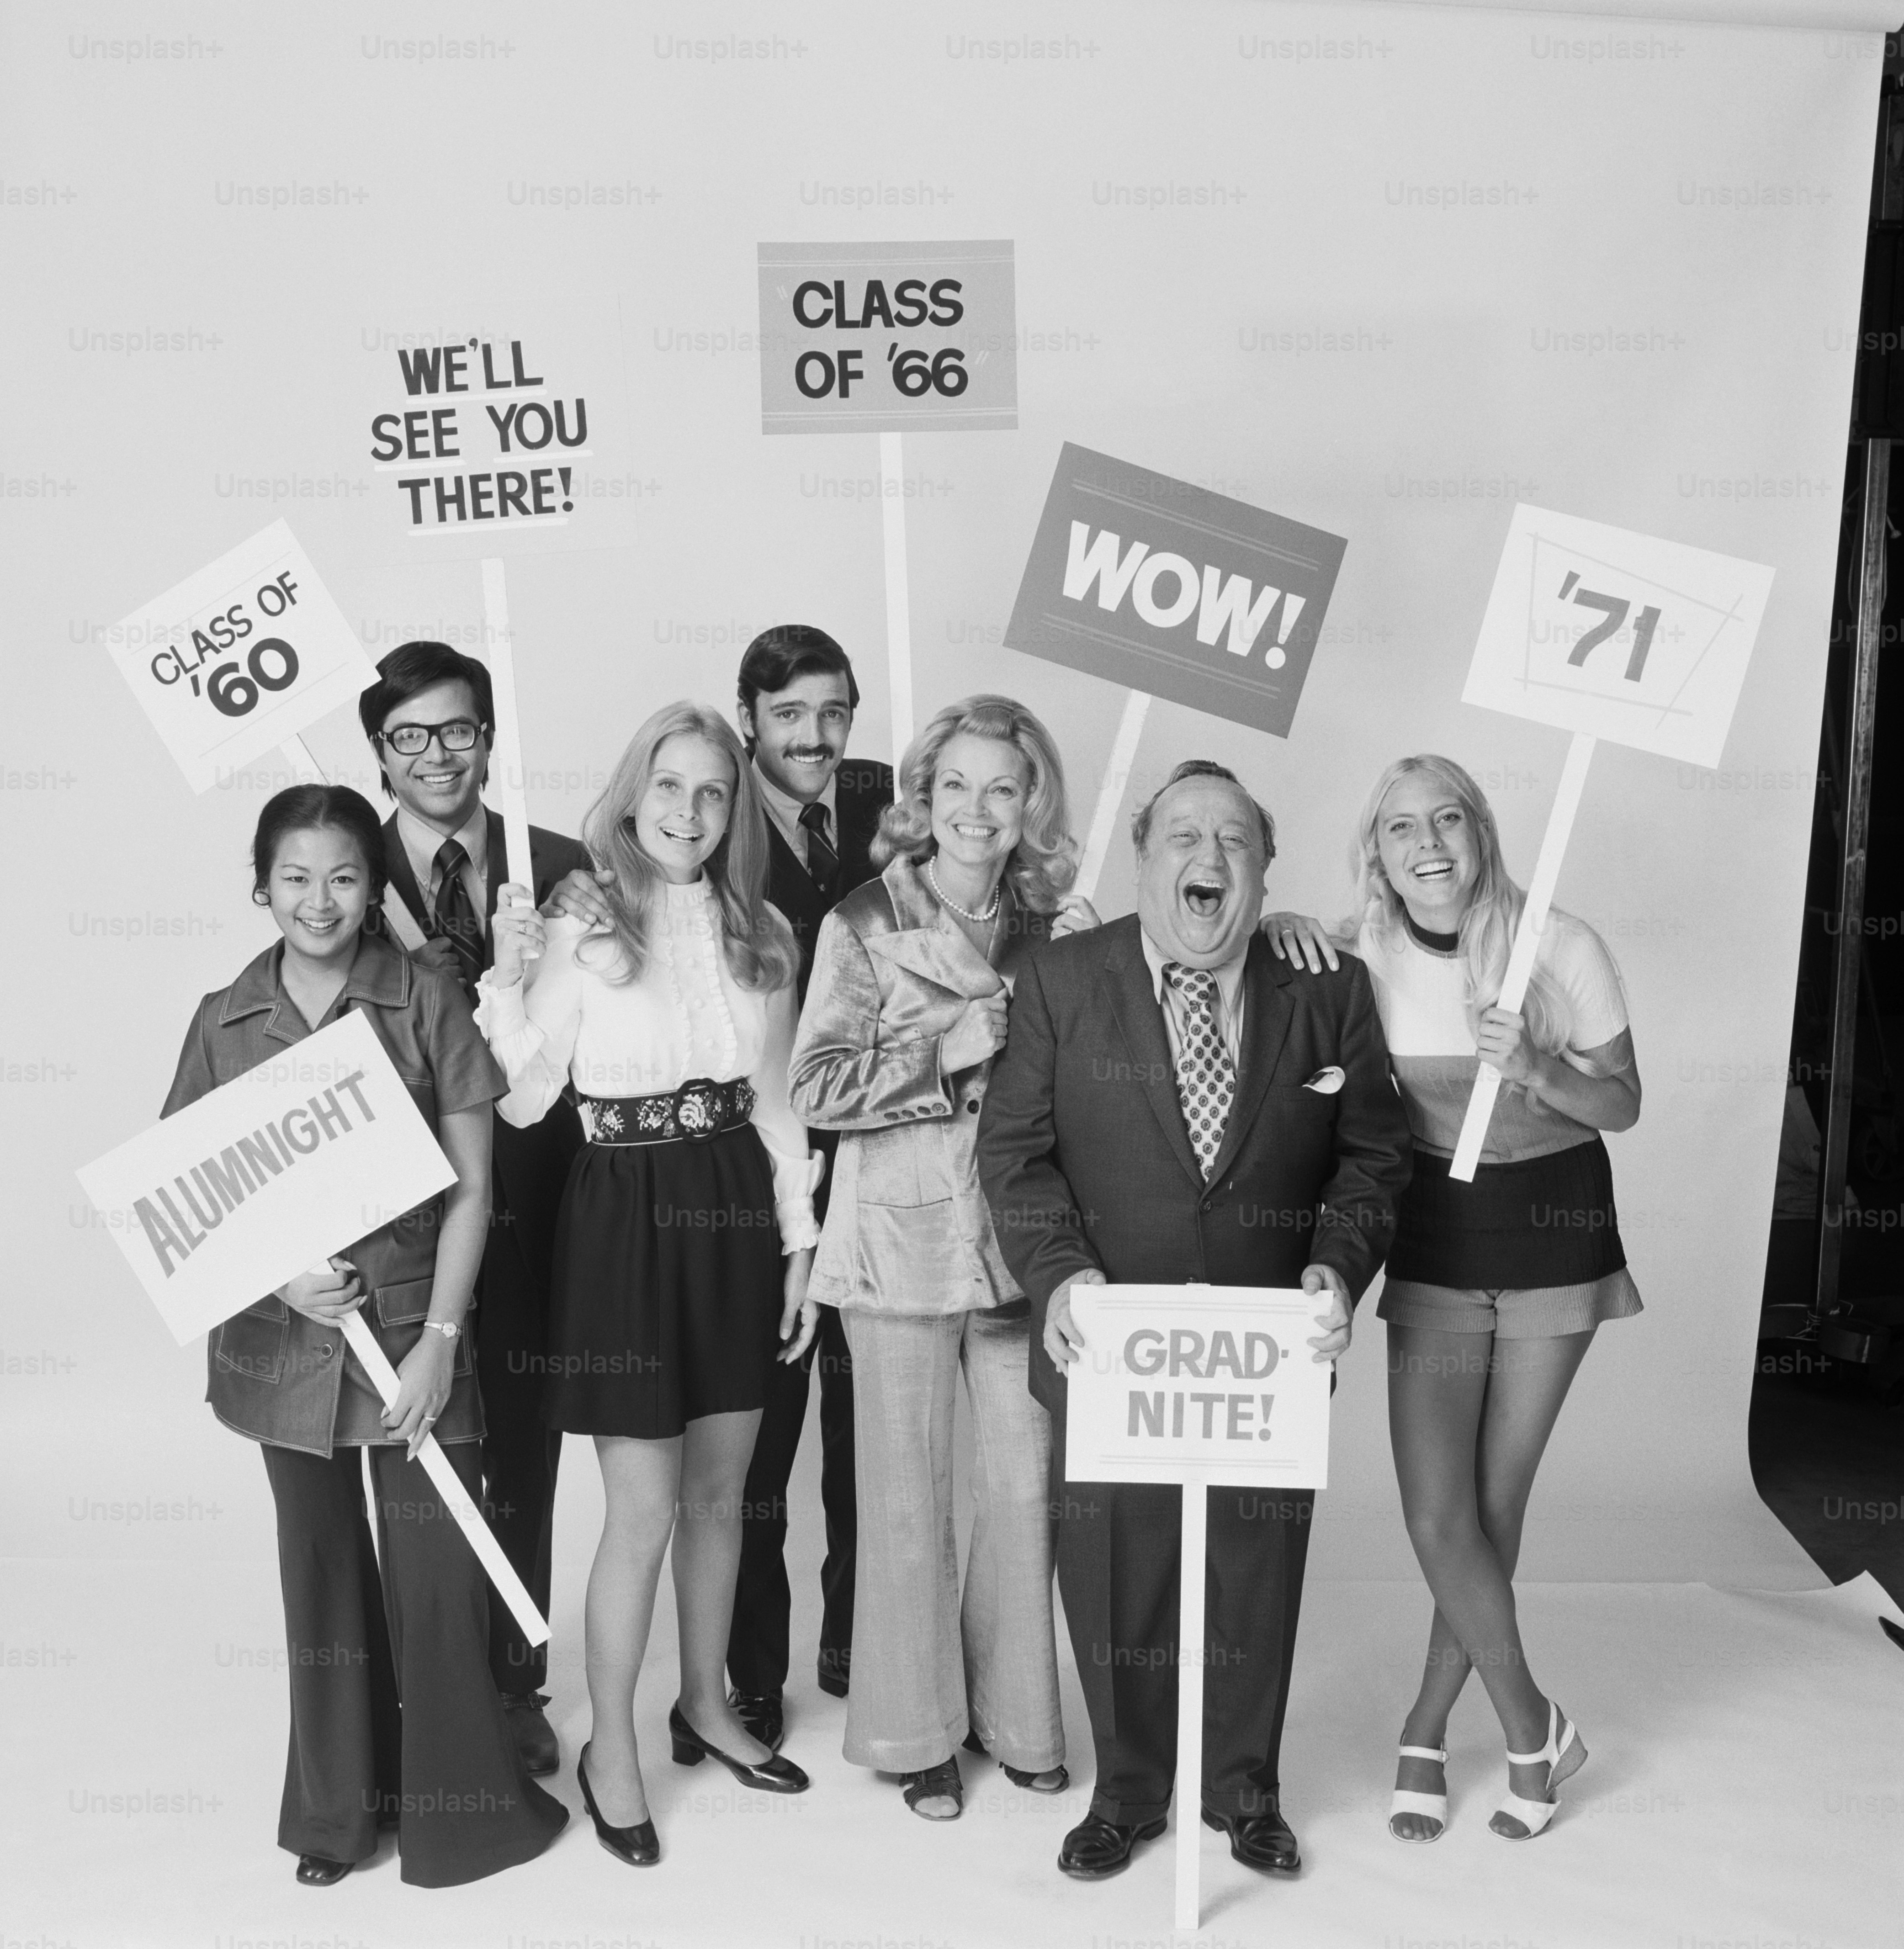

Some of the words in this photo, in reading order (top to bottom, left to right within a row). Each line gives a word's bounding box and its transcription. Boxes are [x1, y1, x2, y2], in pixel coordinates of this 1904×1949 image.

[398, 338, 544, 396] WE'LL
[795, 350, 864, 398] OF
[371, 408, 460, 461] SEE
[485, 398, 588, 453] YOU
[398, 467, 574, 525] THERE!
[151, 604, 253, 685] CLASS
[257, 570, 298, 617] OF
[1062, 519, 1307, 669] WOW!
[1557, 570, 1662, 683] '71
[190, 637, 299, 717] '60
[132, 1069, 377, 1280] ALUMNIGHT
[1127, 1390, 1275, 1441] NITE!
